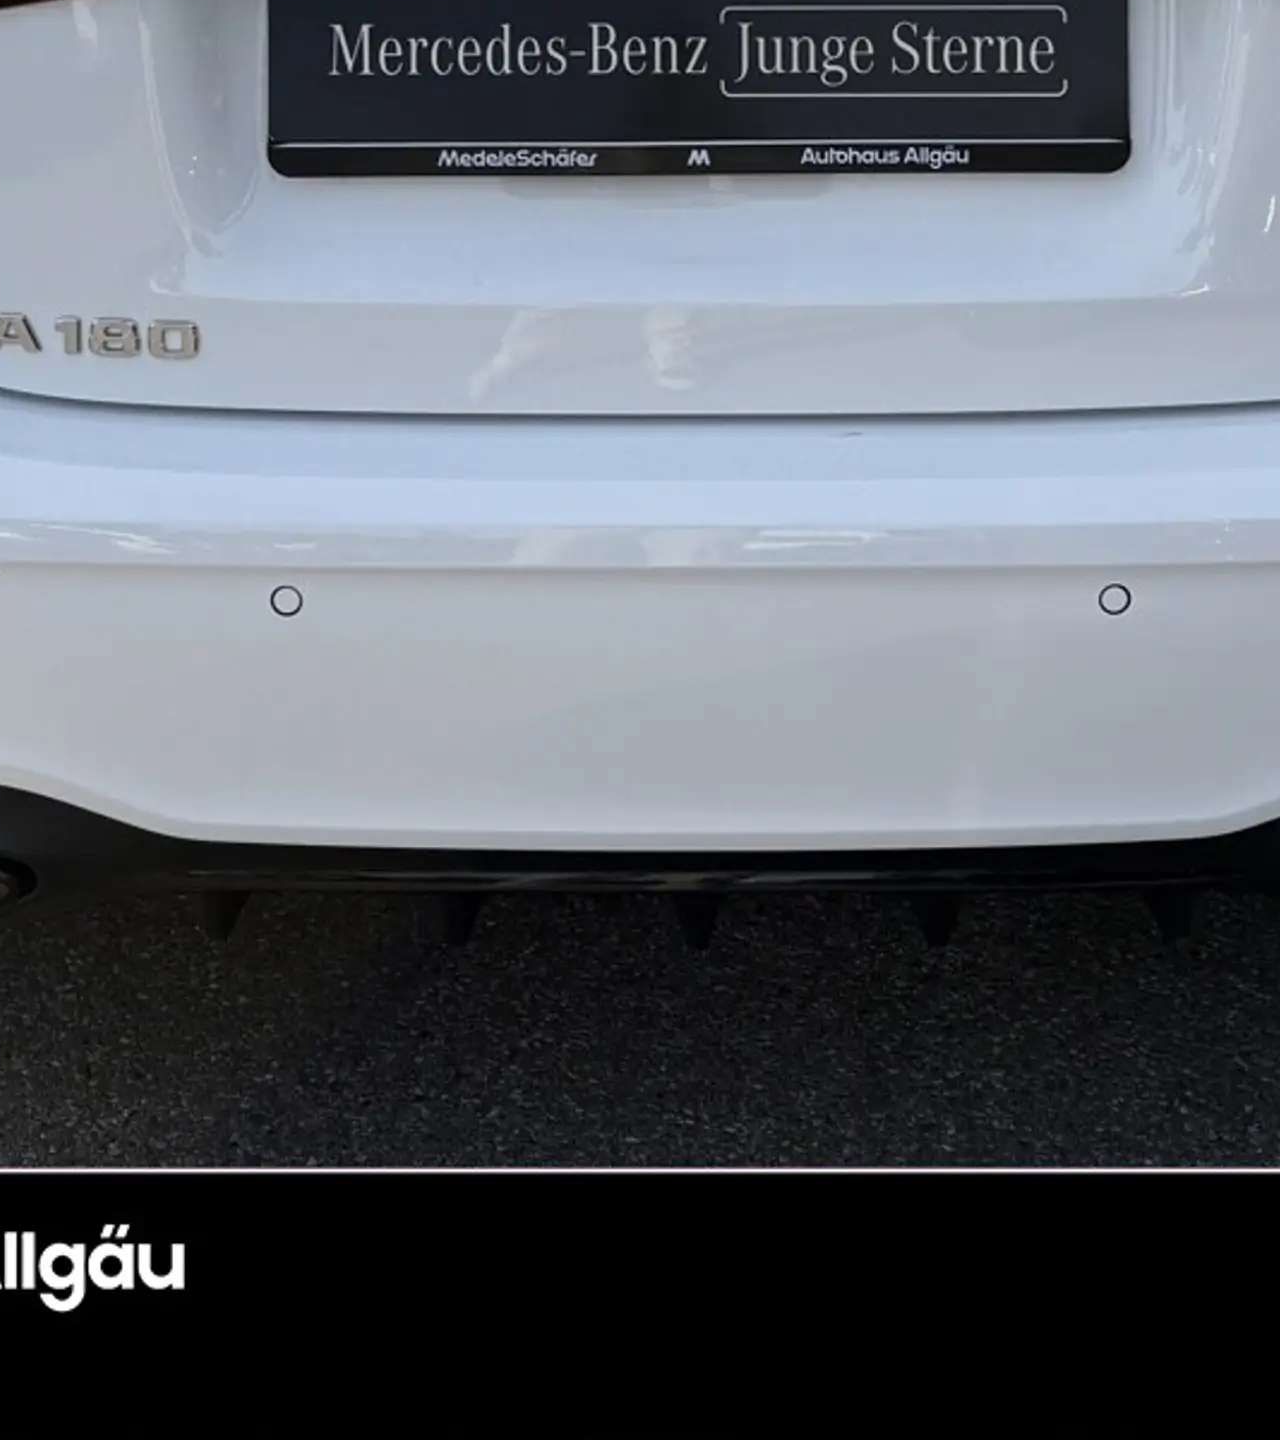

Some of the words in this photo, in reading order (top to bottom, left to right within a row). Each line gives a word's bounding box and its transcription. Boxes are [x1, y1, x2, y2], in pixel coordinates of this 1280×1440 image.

[328, 22, 708, 77] Mercedes-Benz
[734, 22, 876, 87] Junge
[891, 21, 1056, 74] Sterne
[437, 148, 598, 168] MedeleSchäfer
[800, 146, 900, 165] Autohaus
[904, 144, 970, 170] Allgäu
[55, 314, 201, 360] 180
